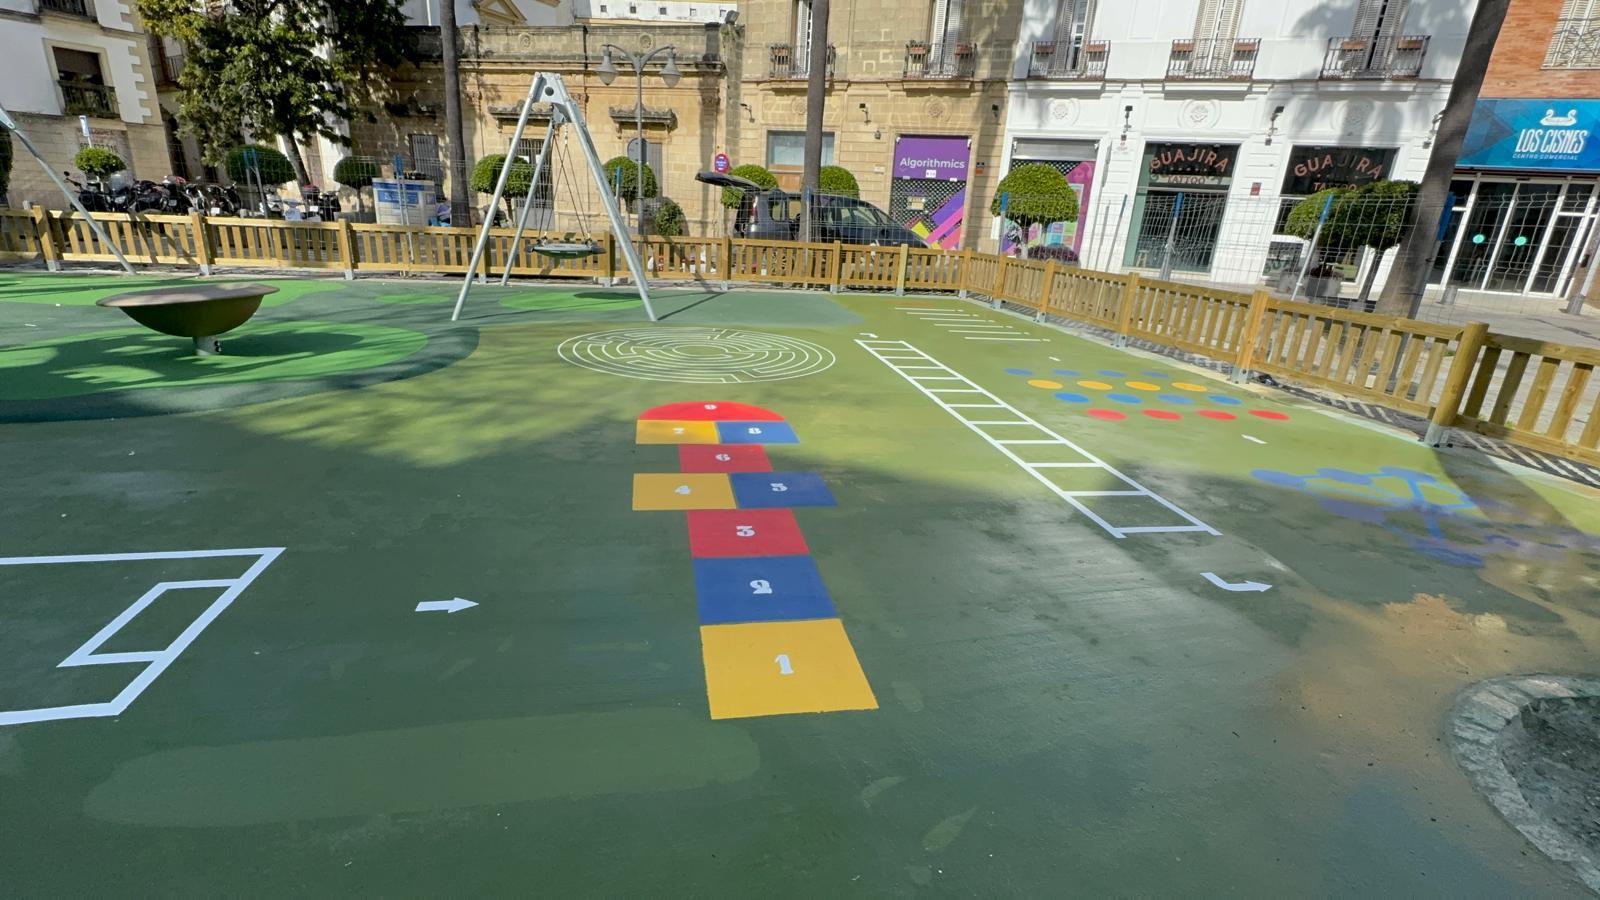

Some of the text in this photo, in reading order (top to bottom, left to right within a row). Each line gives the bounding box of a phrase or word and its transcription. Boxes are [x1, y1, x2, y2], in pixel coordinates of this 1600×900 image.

[1515, 128, 1588, 154] LOS CISNES
[900, 157, 965, 169] Algorithmics
[1150, 148, 1229, 173] GUAJIRA
[1294, 154, 1384, 180] GUAJIRA
[715, 453, 731, 461] 6
[770, 482, 788, 491] 5
[736, 525, 755, 537] 3
[750, 579, 773, 594] 2
[774, 654, 794, 674] 1
